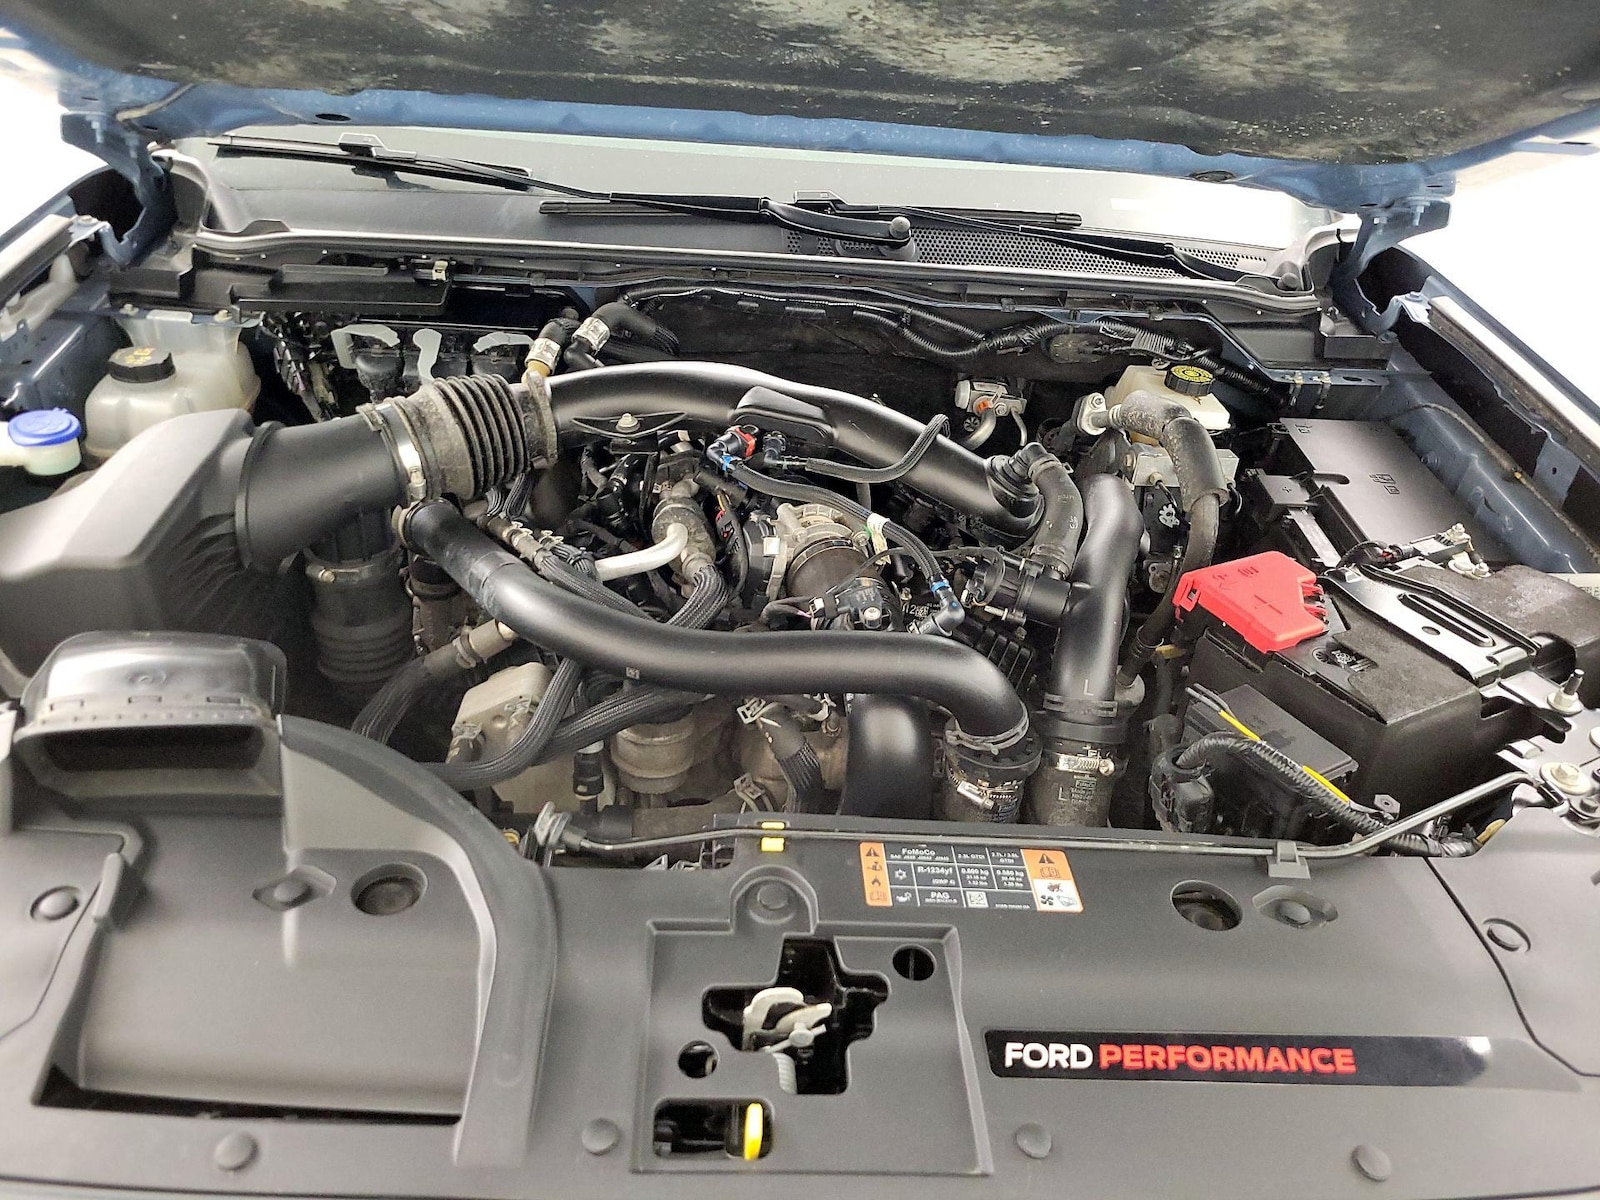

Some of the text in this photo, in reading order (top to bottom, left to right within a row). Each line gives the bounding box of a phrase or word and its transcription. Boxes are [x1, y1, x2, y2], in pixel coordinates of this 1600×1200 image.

[1083, 679, 1094, 696] L
[1058, 786, 1068, 802] L
[902, 847, 936, 856] FoMoCo
[917, 866, 953, 875] R-1234yf
[980, 868, 989, 876] kg
[930, 891, 950, 899] PAG
[1004, 1042, 1357, 1074] FORD PERFORMANCE
